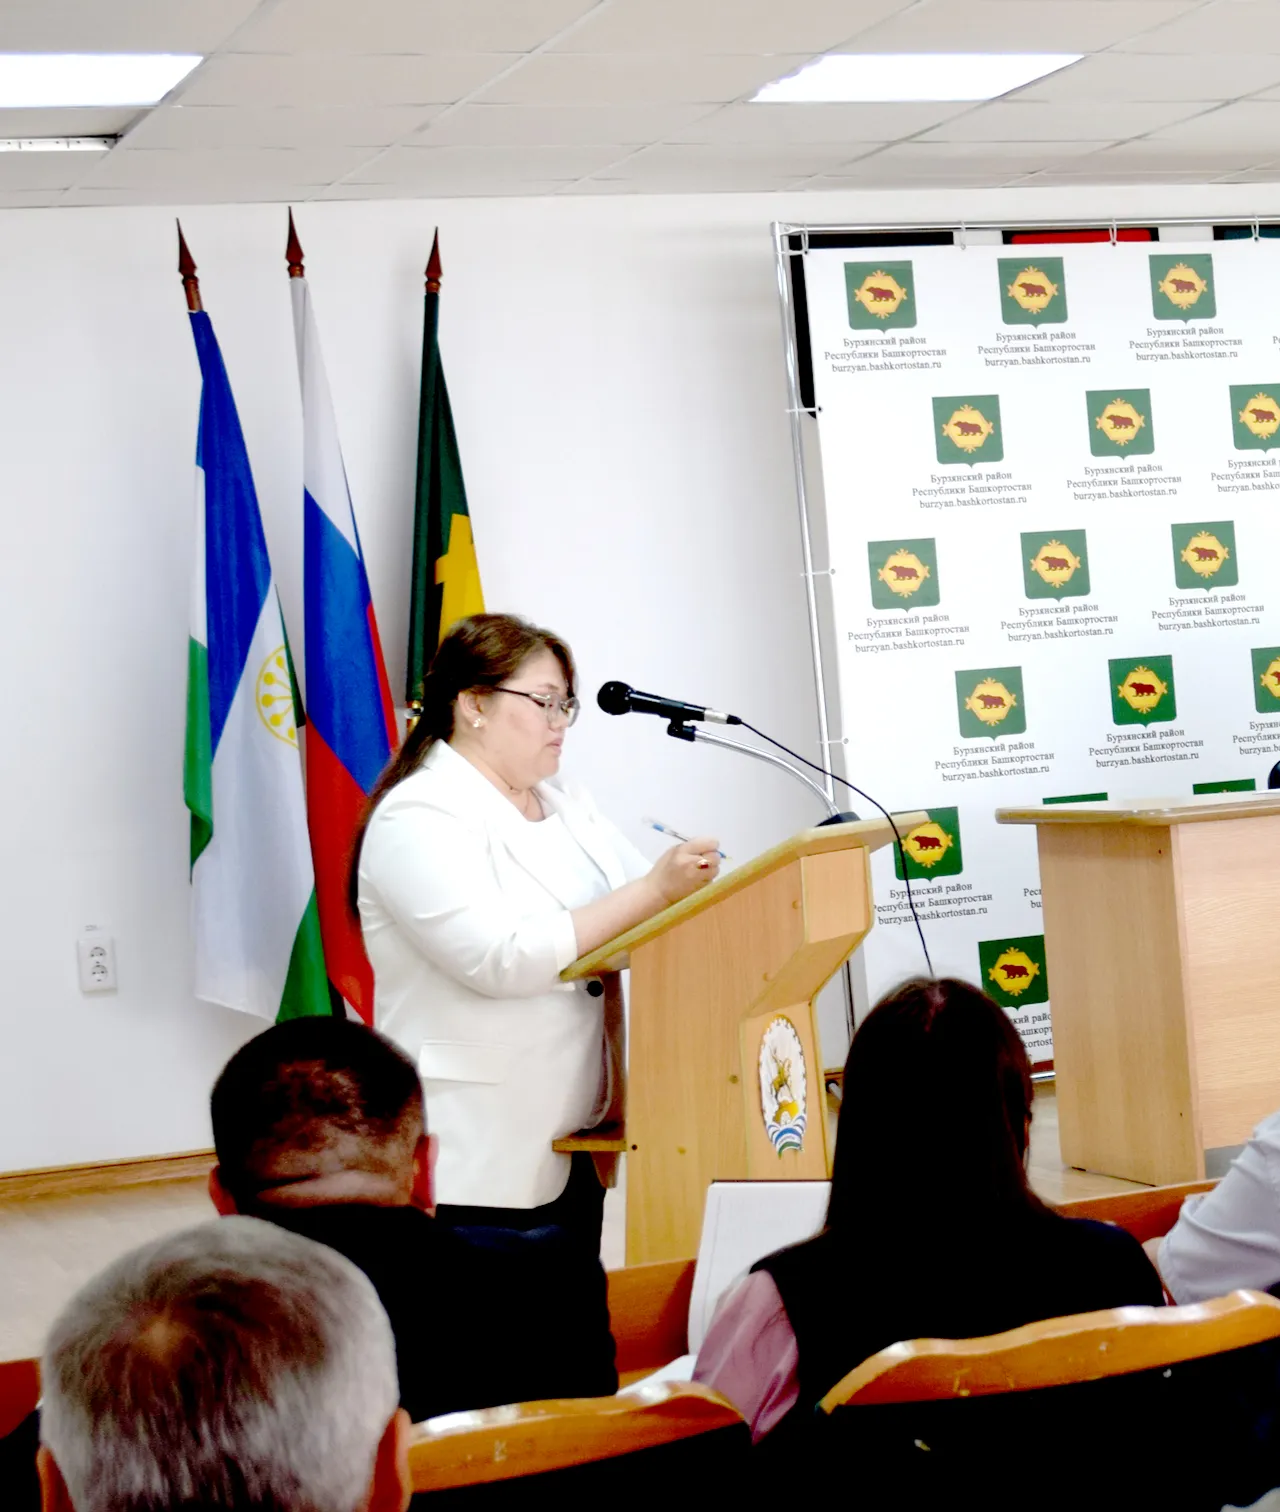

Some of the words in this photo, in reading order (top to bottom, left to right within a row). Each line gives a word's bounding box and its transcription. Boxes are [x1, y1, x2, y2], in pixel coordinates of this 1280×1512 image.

[995, 331, 1048, 344] Бурзянский
[1049, 331, 1076, 342] район
[1146, 326, 1196, 338] Бурзянский
[1198, 326, 1224, 337] район
[842, 336, 896, 349] Бурзянский
[898, 336, 926, 347] район
[977, 344, 1030, 356] Республики
[1032, 343, 1096, 354] Башкортостан
[1128, 339, 1180, 350] Республики
[1182, 338, 1242, 349] Башкортостан
[824, 349, 879, 361] Республики
[881, 348, 946, 359] Башкортостан
[984, 355, 1091, 368] burzyan.bashkortostan.ru
[1135, 350, 1238, 362] burzyan.bashkortostan.ru
[831, 361, 942, 374] burzyan.bashkortostan.ru
[1084, 464, 1135, 477] Бурзянский
[1136, 463, 1163, 475] район
[1227, 457, 1276, 470] Бурзянский
[930, 472, 984, 485] Бурзянский
[985, 471, 1012, 483] район
[1066, 478, 1118, 489] Республики
[1120, 476, 1182, 487] Башкортостан
[1210, 470, 1260, 482] Республики
[912, 486, 966, 498] Республики
[968, 483, 1032, 494] Башкортостан
[1072, 488, 1178, 502] burzyan.bashkortostan.ru
[919, 496, 1027, 510] burzyan.bashkortostan.ru
[1168, 594, 1218, 608] Бурзянский
[1220, 593, 1246, 605] район
[1018, 604, 1070, 618] Бурзянский
[1072, 603, 1099, 615] район
[1151, 608, 1202, 620] Республики
[1204, 604, 1264, 616] Башкортостан
[866, 615, 920, 629] Бурзянский
[922, 613, 950, 625] район
[1000, 618, 1054, 630] Республики
[1055, 615, 1118, 626] Башкортостан
[1158, 617, 1260, 632] burzyan.bashkortostan.ru
[847, 629, 902, 641] Республики
[904, 625, 970, 637] Башкортостан
[1007, 627, 1114, 643] burzyan.bashkortostan.ru
[854, 638, 964, 654] burzyan.bashkortostan.ru
[1106, 730, 1157, 744] Бурзянский
[1158, 728, 1184, 740] район
[952, 742, 1006, 757] Бурзянский
[1008, 741, 1034, 753] район
[1088, 744, 1140, 757] Республики
[1142, 739, 1204, 752] Башкортостан
[934, 758, 989, 770] Республики
[990, 752, 1054, 765] Башкортостан
[1095, 752, 1200, 768] burzyan.bashkortostan.ru
[941, 765, 1050, 782] burzyan.bashkortostan.ru
[889, 885, 943, 900] Бурянский
[945, 883, 972, 894] район
[873, 898, 926, 914] еспублки
[928, 894, 992, 907] Башкортостан
